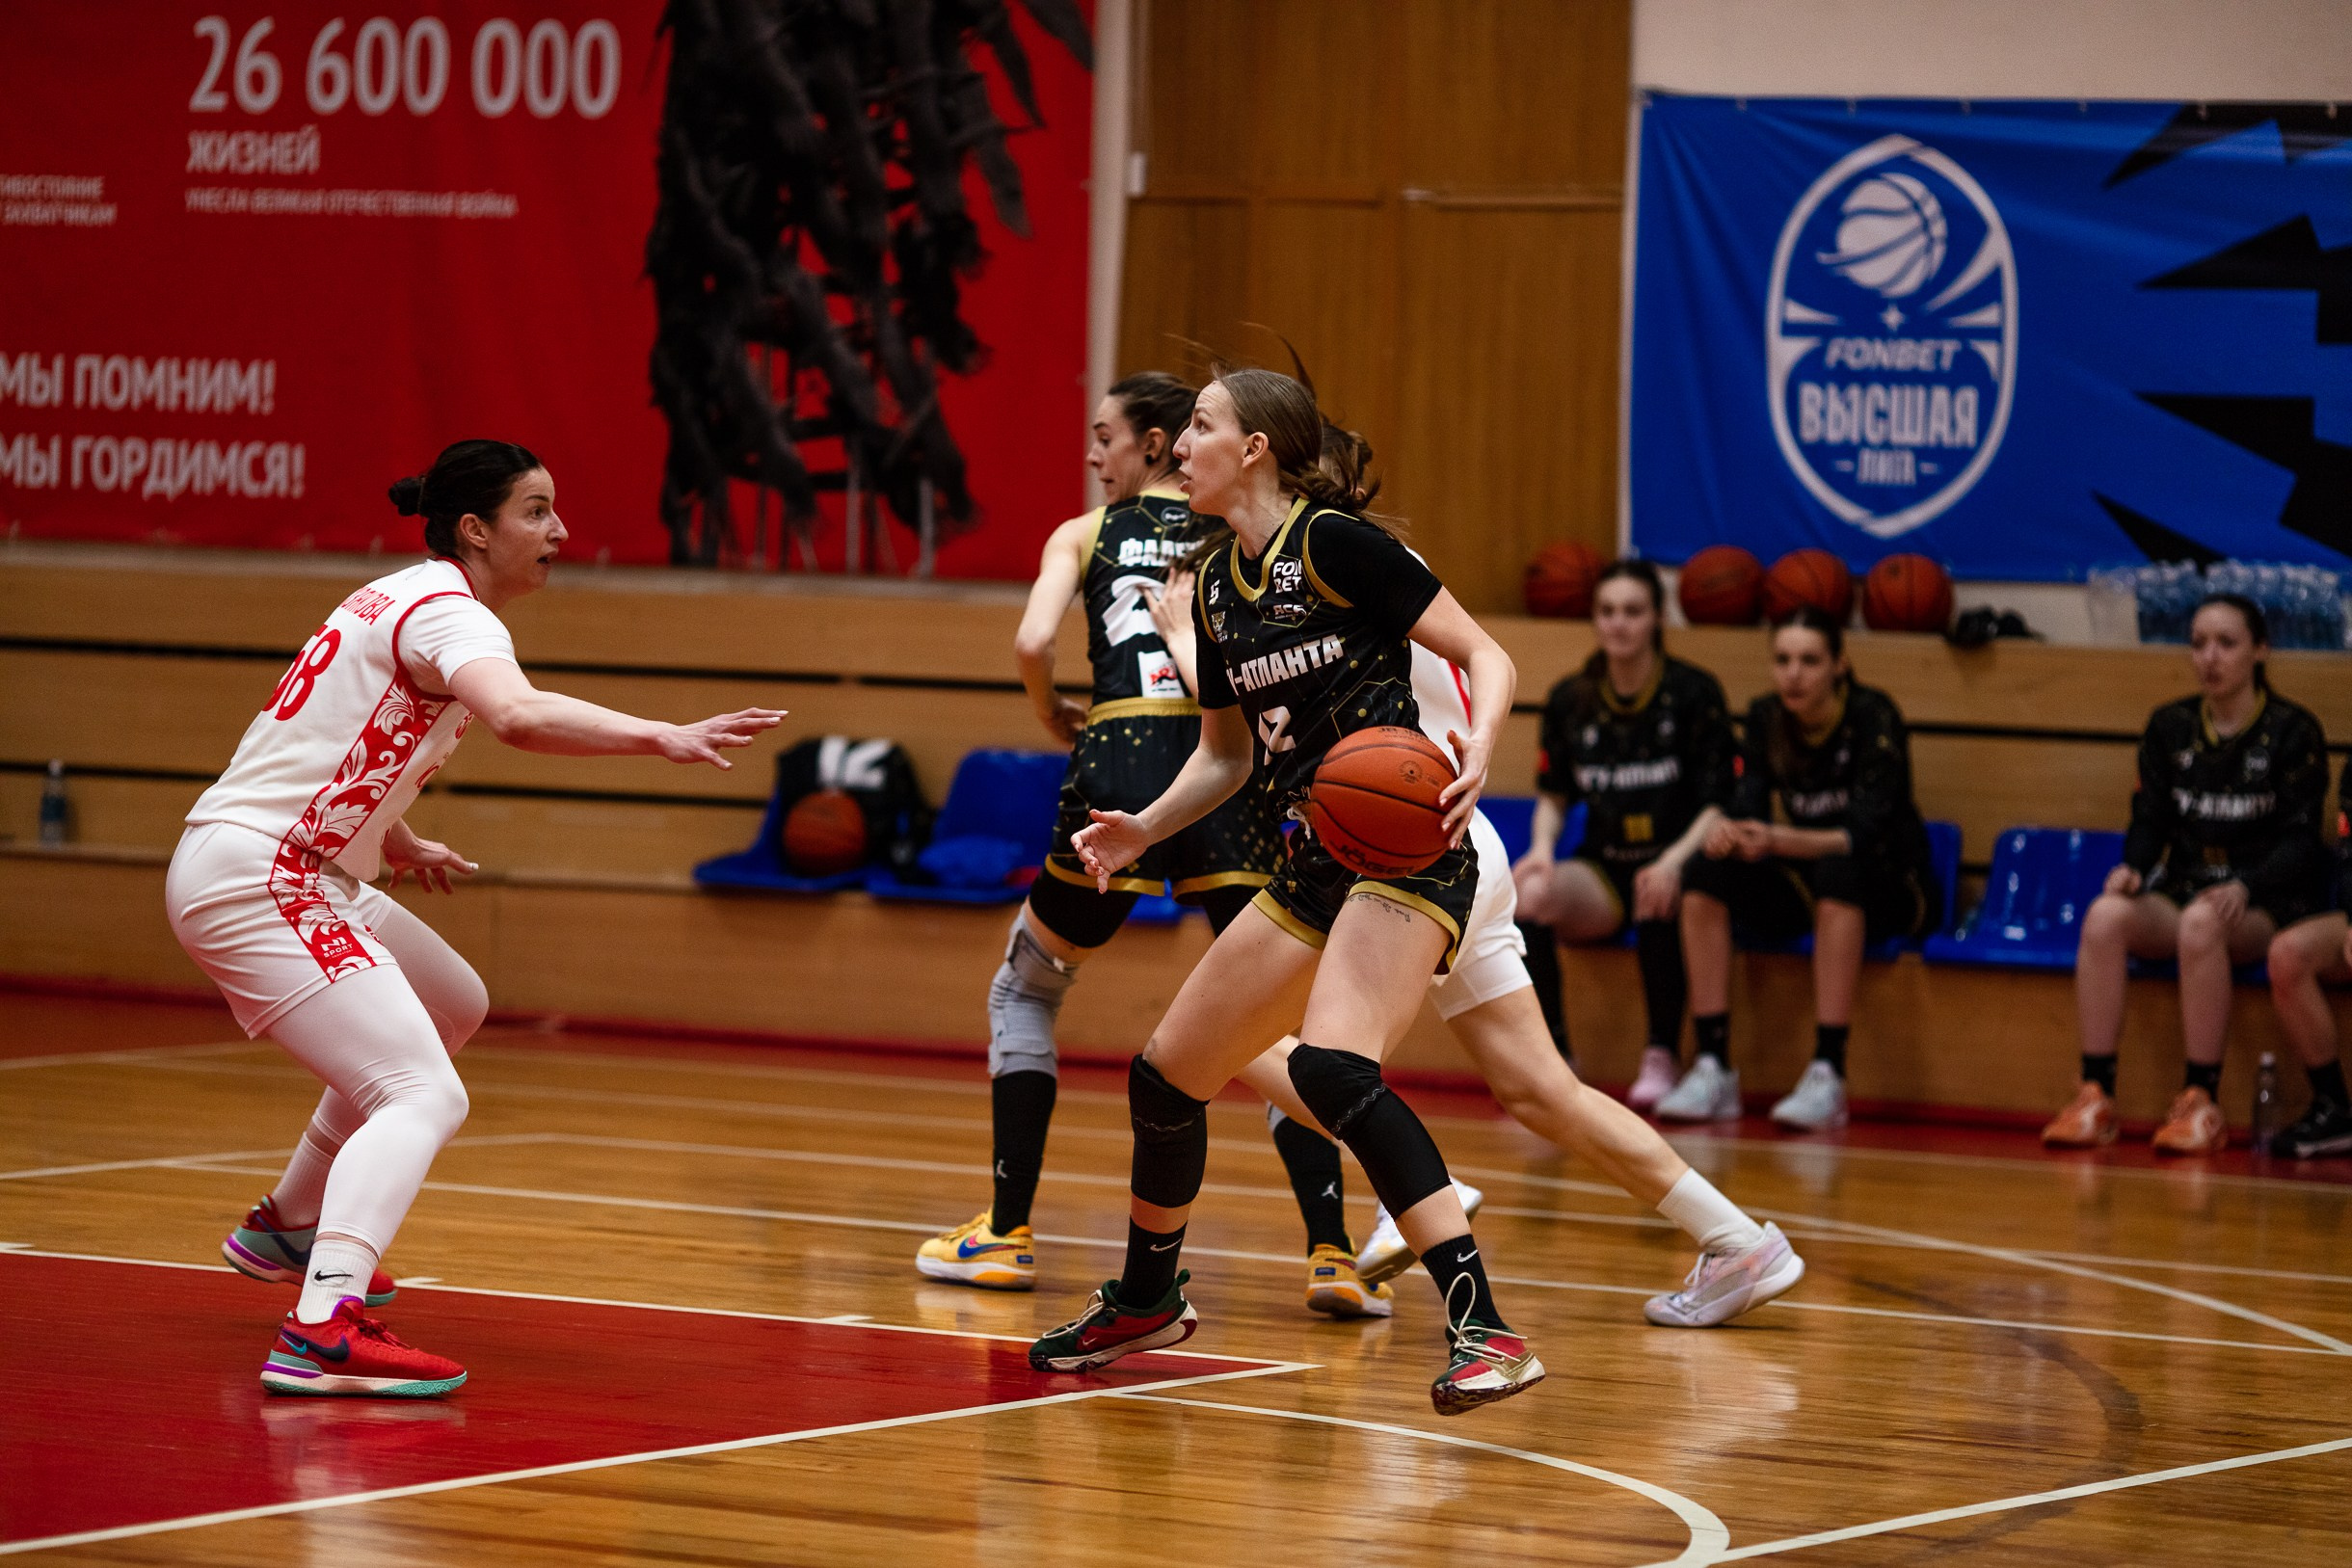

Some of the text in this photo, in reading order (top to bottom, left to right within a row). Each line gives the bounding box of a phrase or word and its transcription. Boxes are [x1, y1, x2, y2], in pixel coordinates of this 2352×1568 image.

[190, 15, 622, 120] 26 600 000
[187, 124, 320, 174] ЖИЗНЕЙ
[1825, 338, 1960, 371] FONBET
[0, 352, 277, 415] МЫ ПОМНИМ!
[1799, 383, 1979, 448] ВЫСШАЯ
[0, 433, 306, 502] МЫ ГОРДИМСЯ!
[1273, 576, 1301, 594] BET
[323, 943, 353, 958] SPORT
